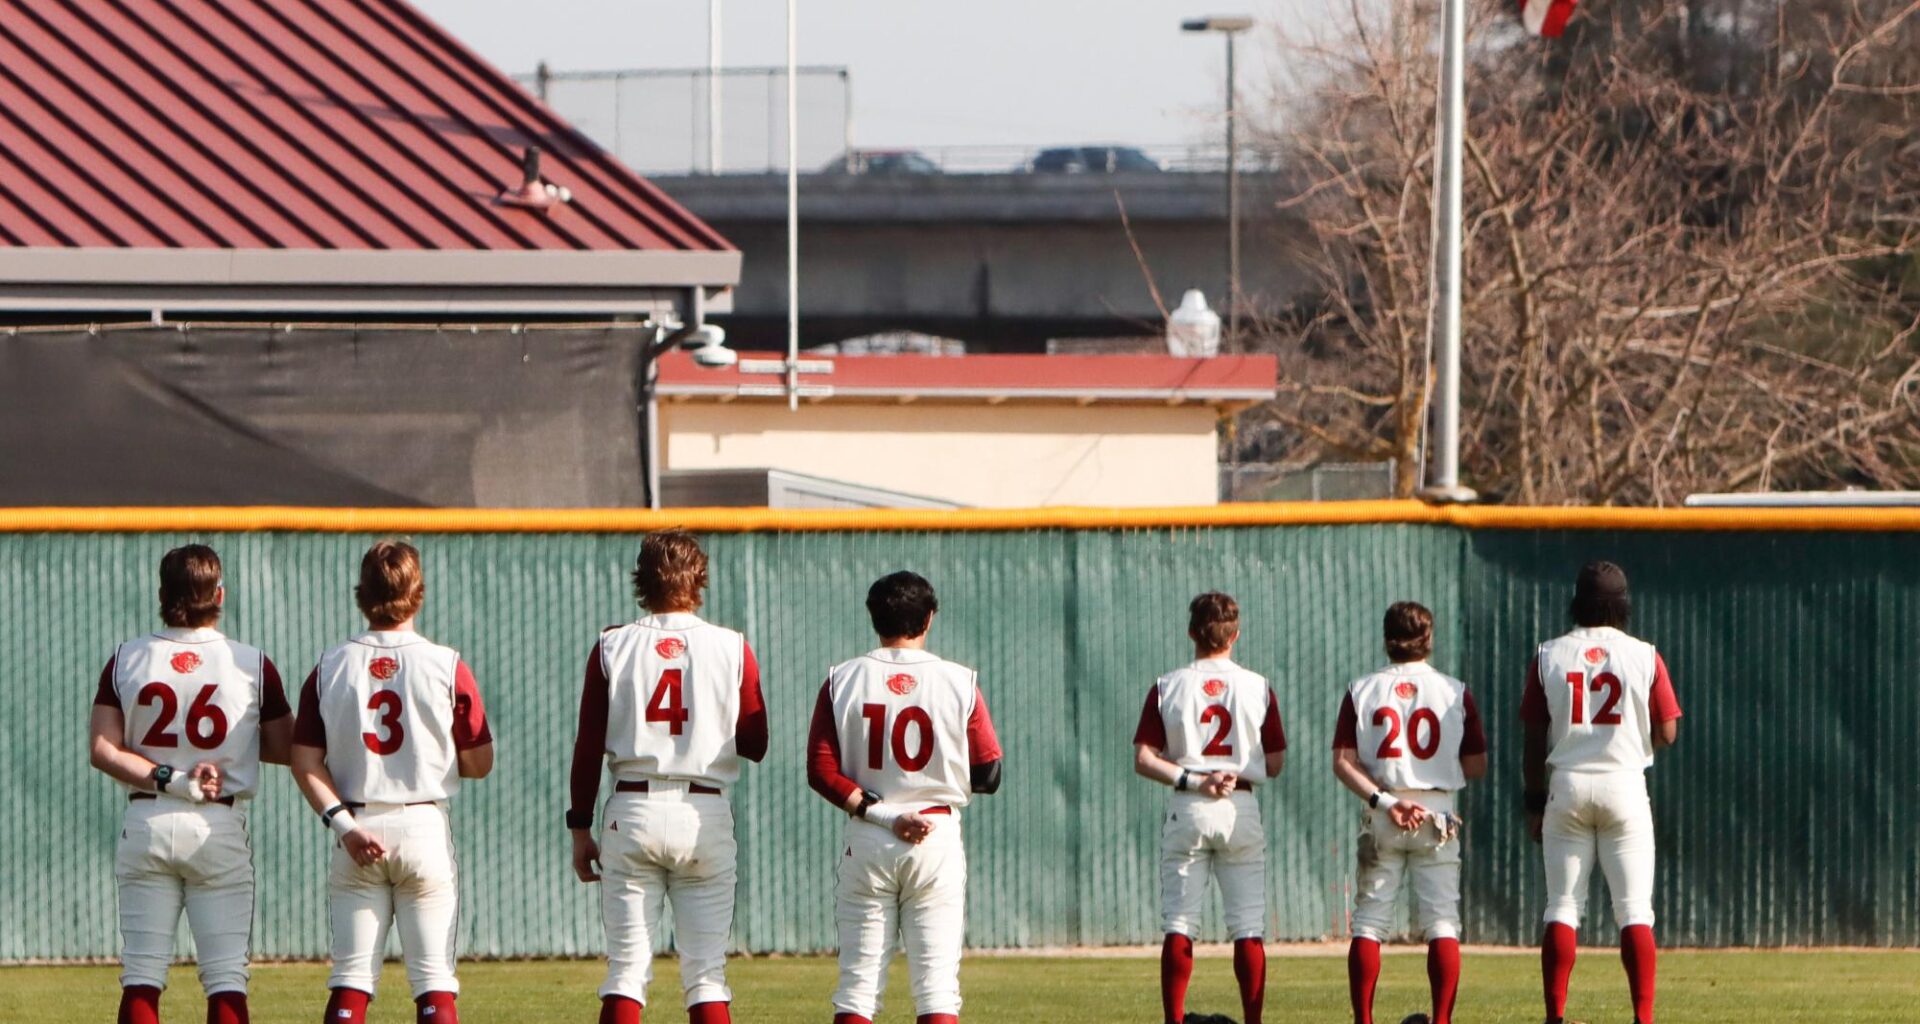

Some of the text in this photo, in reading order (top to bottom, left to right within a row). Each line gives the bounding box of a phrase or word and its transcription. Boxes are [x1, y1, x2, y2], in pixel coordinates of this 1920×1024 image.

[137, 683, 228, 749] 26
[362, 689, 404, 755] 3
[646, 669, 689, 735] 4
[1200, 704, 1233, 757] 2
[1566, 671, 1622, 725] 12
[862, 703, 934, 772] 10
[1372, 706, 1441, 760] 20
